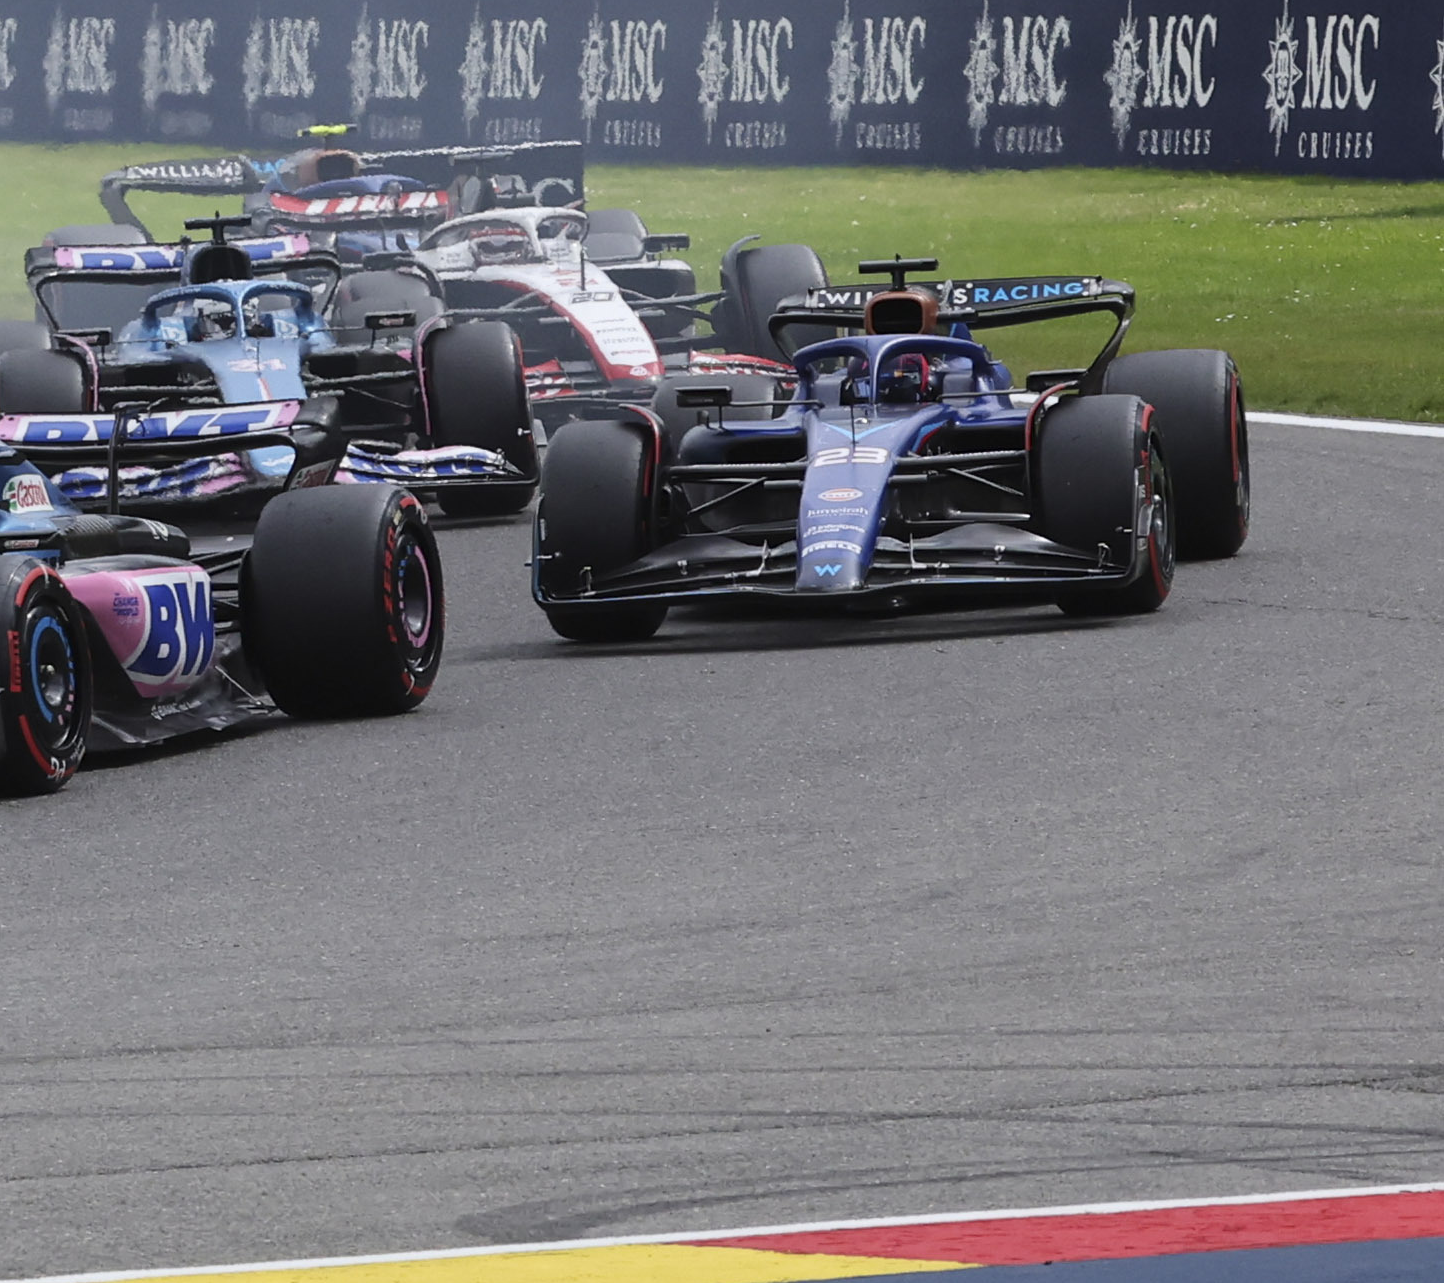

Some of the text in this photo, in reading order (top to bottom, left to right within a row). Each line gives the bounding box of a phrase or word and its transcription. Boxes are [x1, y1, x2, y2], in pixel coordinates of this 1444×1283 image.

[486, 19, 548, 100] MSC
[606, 19, 668, 102] MSC
[729, 18, 793, 104] MSC
[859, 17, 926, 105] MSC
[998, 16, 1071, 107] MSC
[1144, 15, 1217, 109] MSC
[1300, 14, 1381, 111] MSC
[1297, 130, 1375, 160] CRUISES
[974, 281, 1082, 304] RACING
[16, 480, 49, 508] Castrol
[813, 446, 888, 467] 23
